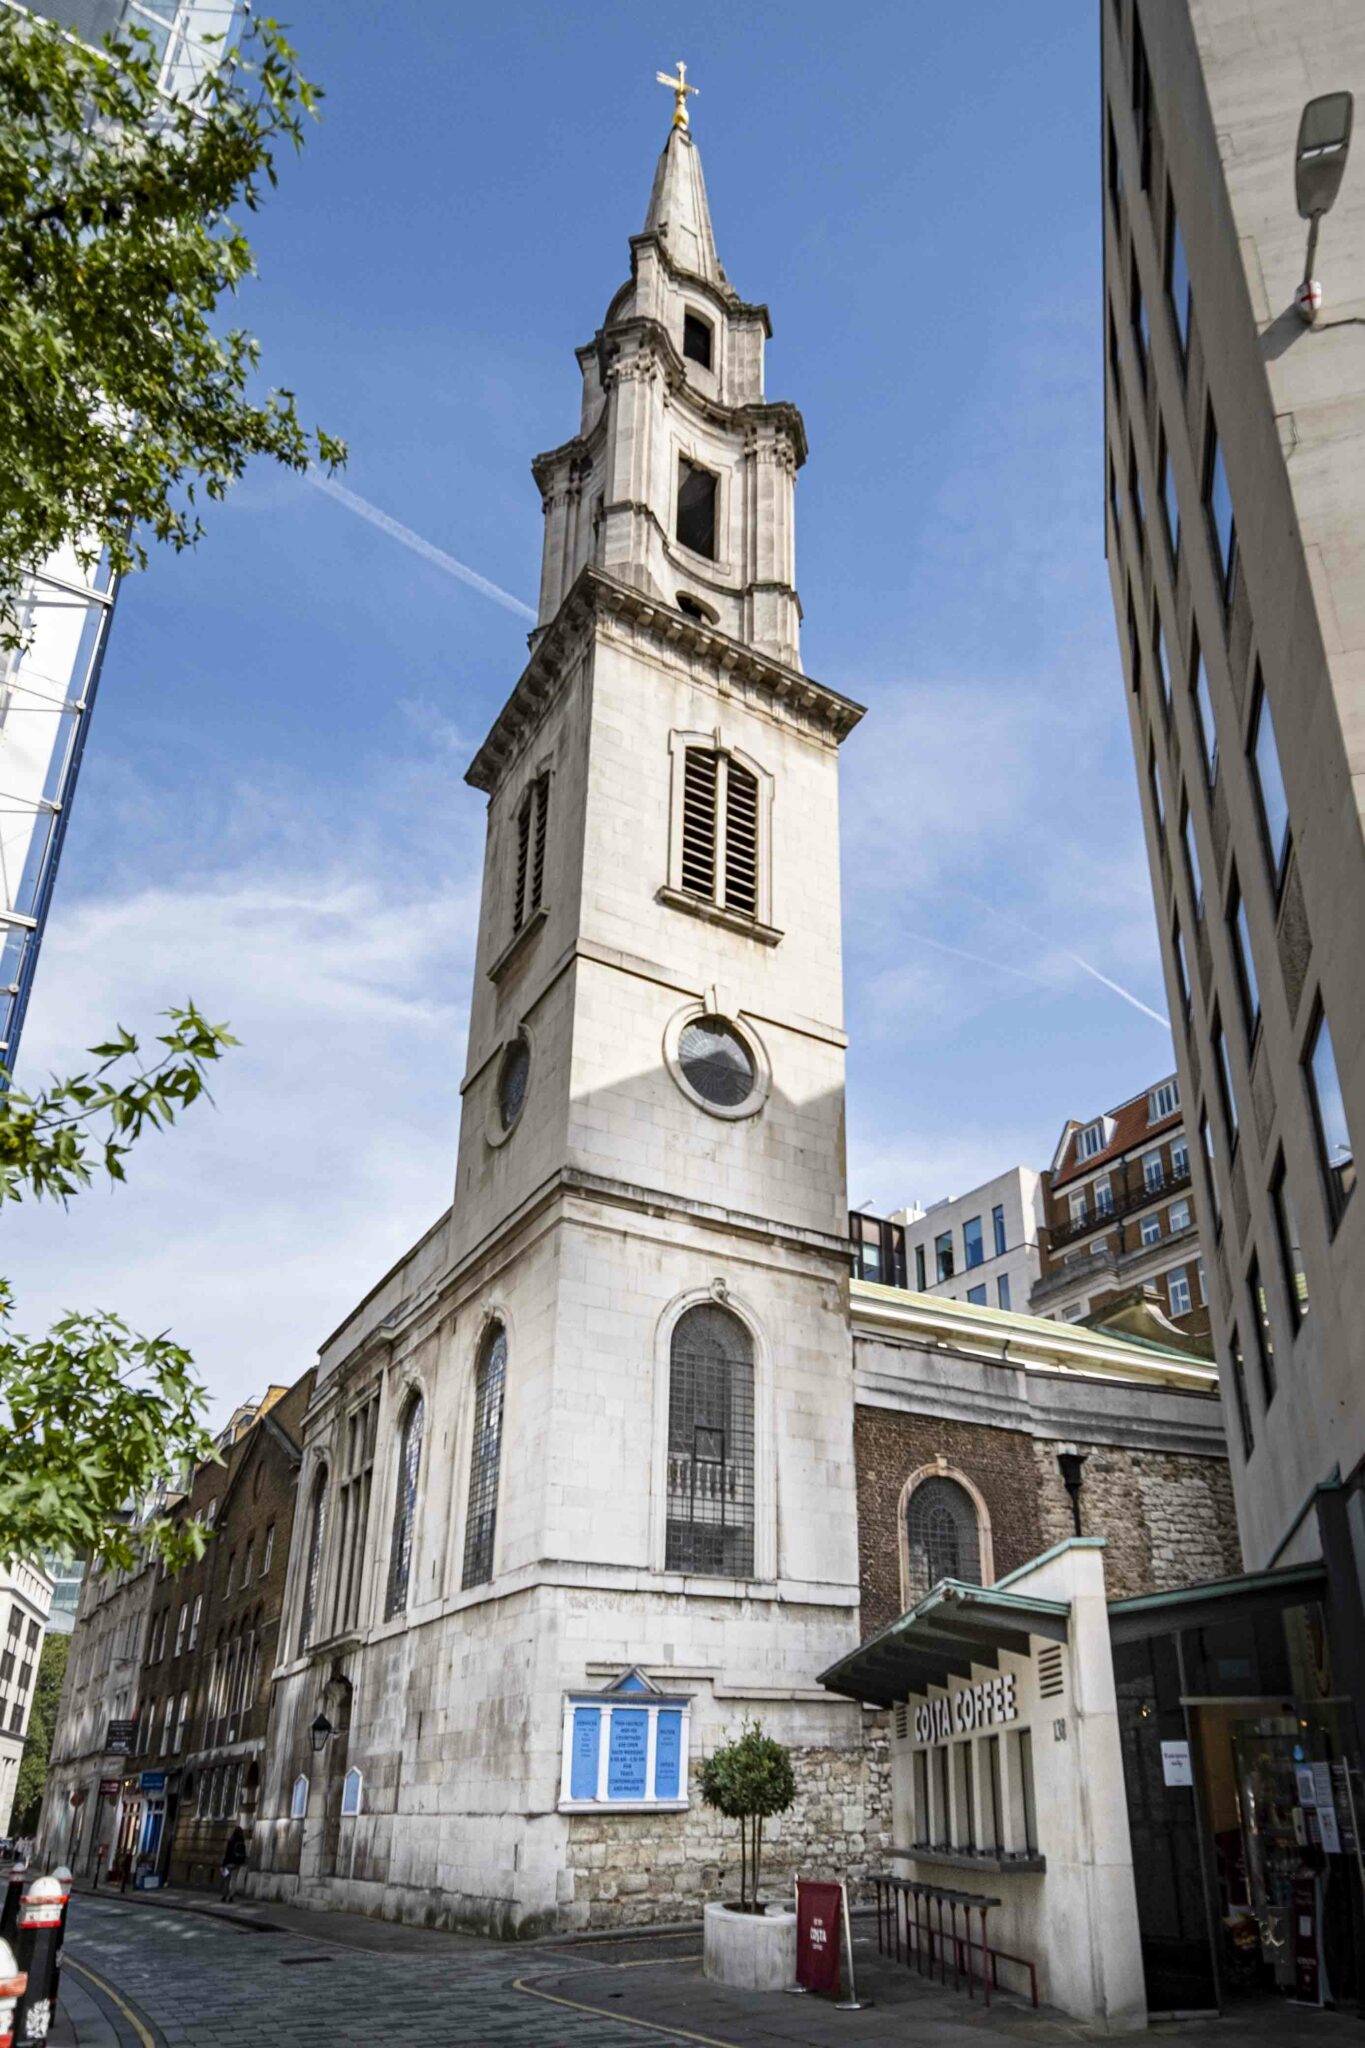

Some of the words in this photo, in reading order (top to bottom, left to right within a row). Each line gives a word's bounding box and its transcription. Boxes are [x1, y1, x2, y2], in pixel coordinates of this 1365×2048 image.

[915, 1695, 953, 1745] COSTA
[955, 1673, 1018, 1732] COFFEE
[810, 1926, 827, 1943] COSTA
